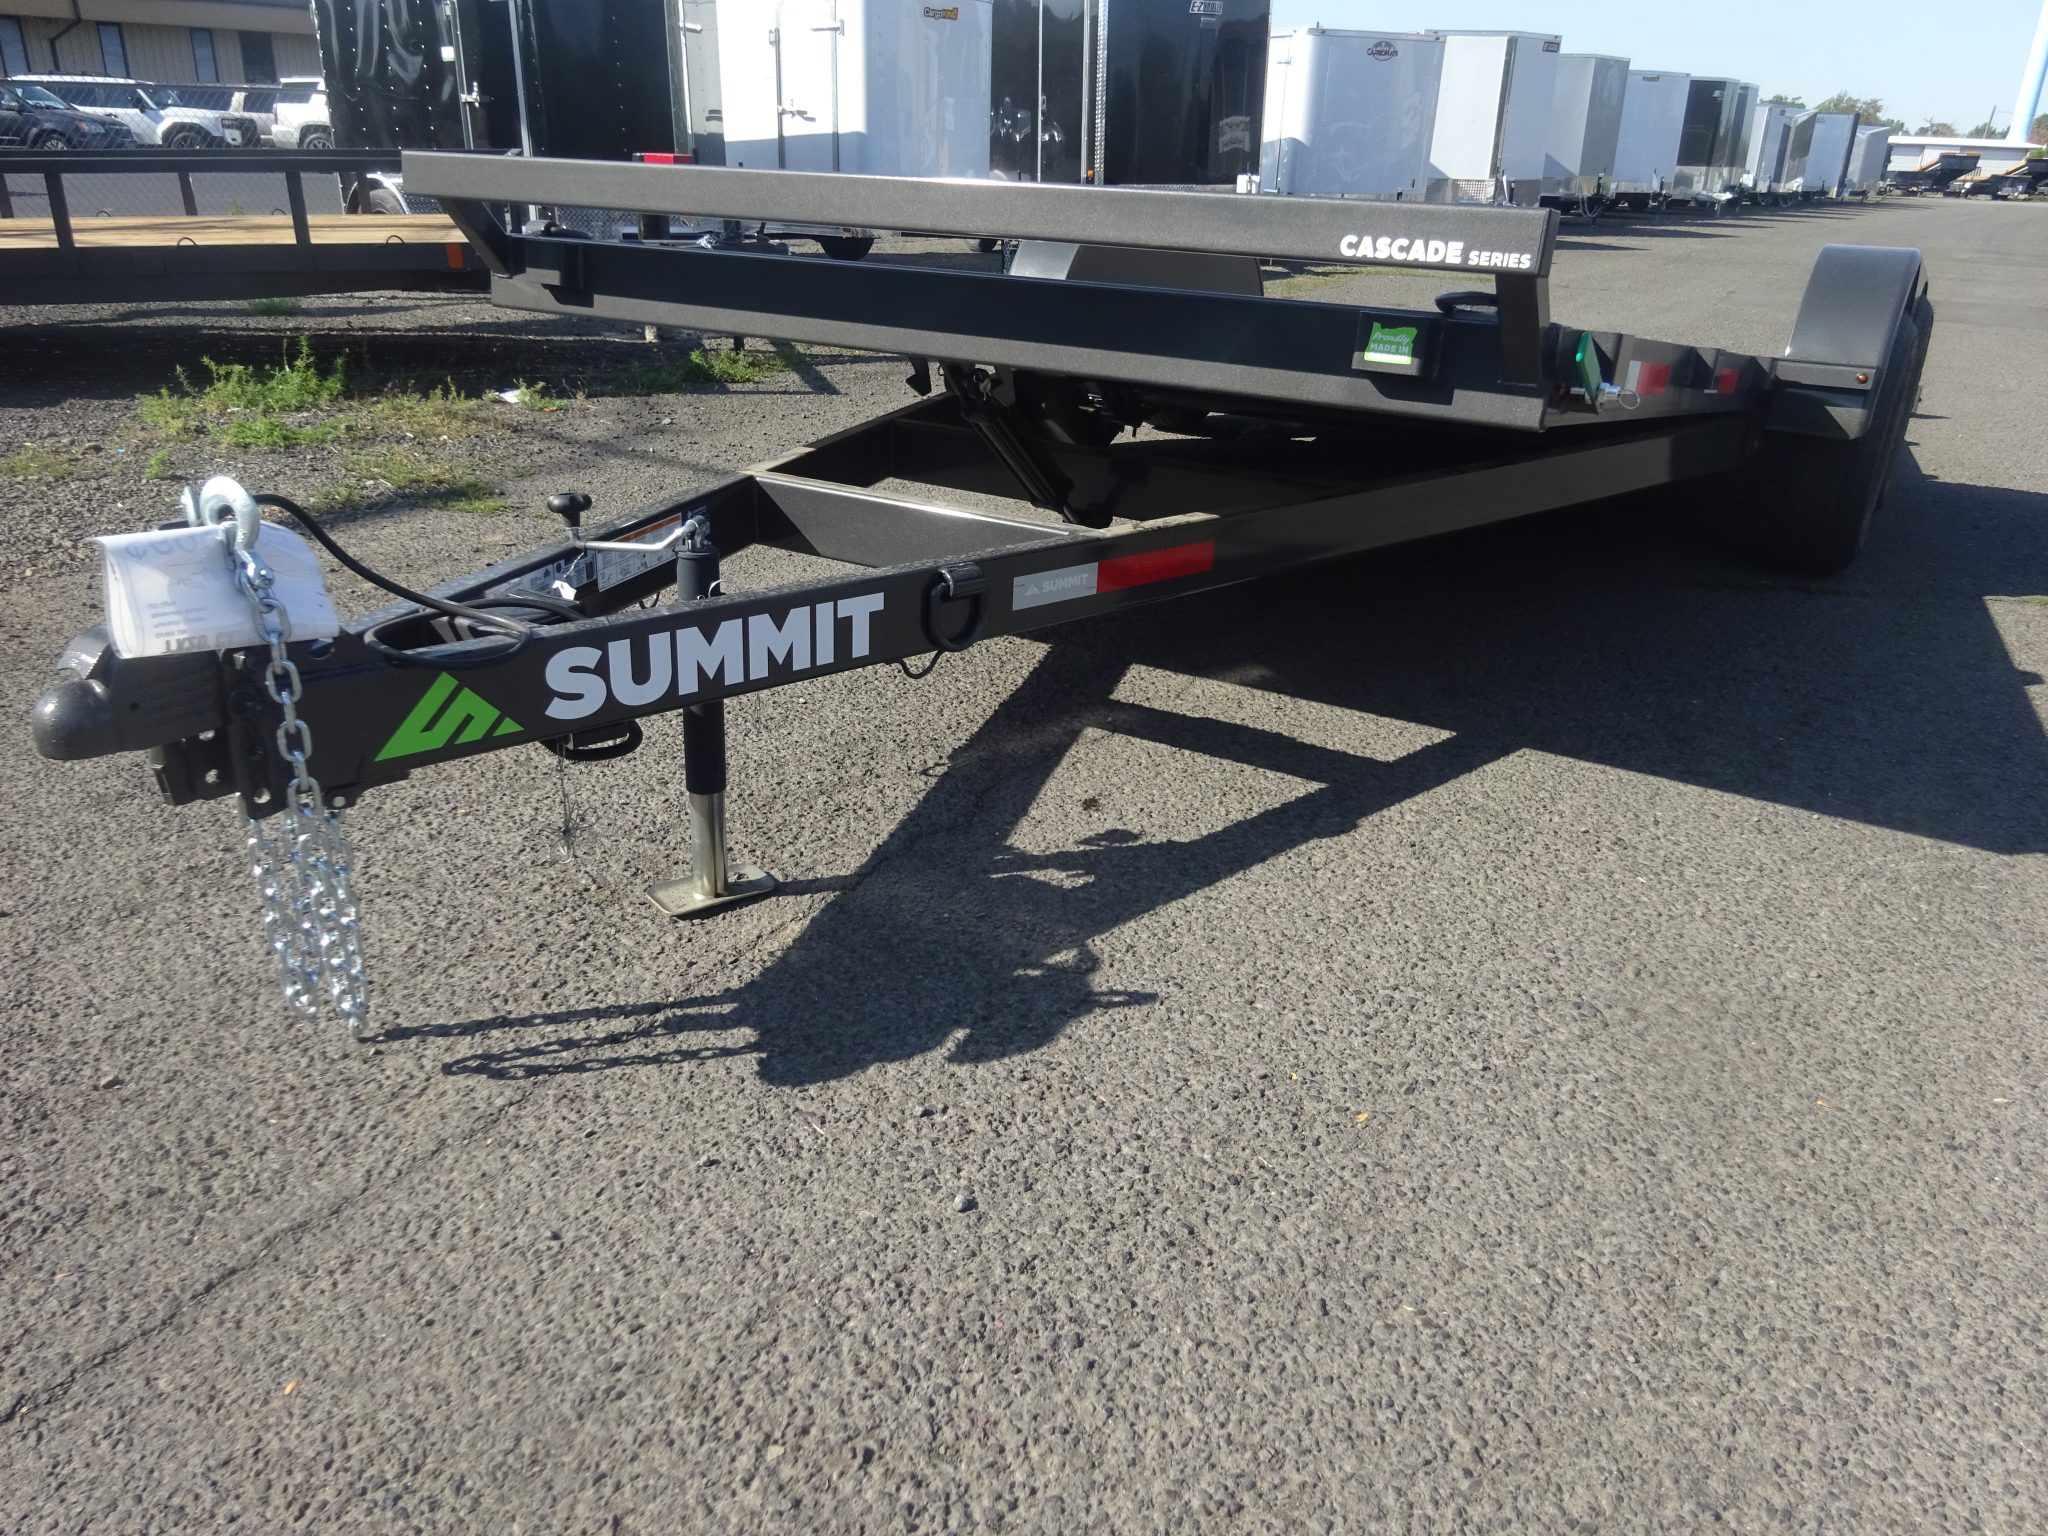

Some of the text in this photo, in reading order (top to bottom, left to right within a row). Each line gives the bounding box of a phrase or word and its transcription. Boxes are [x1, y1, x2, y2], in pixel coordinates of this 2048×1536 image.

[1340, 235, 1531, 269] CASCADE SERIES
[1370, 343, 1409, 354] MADE IN
[1042, 573, 1089, 593] SUMMIT
[544, 592, 885, 720] SUMMIT
